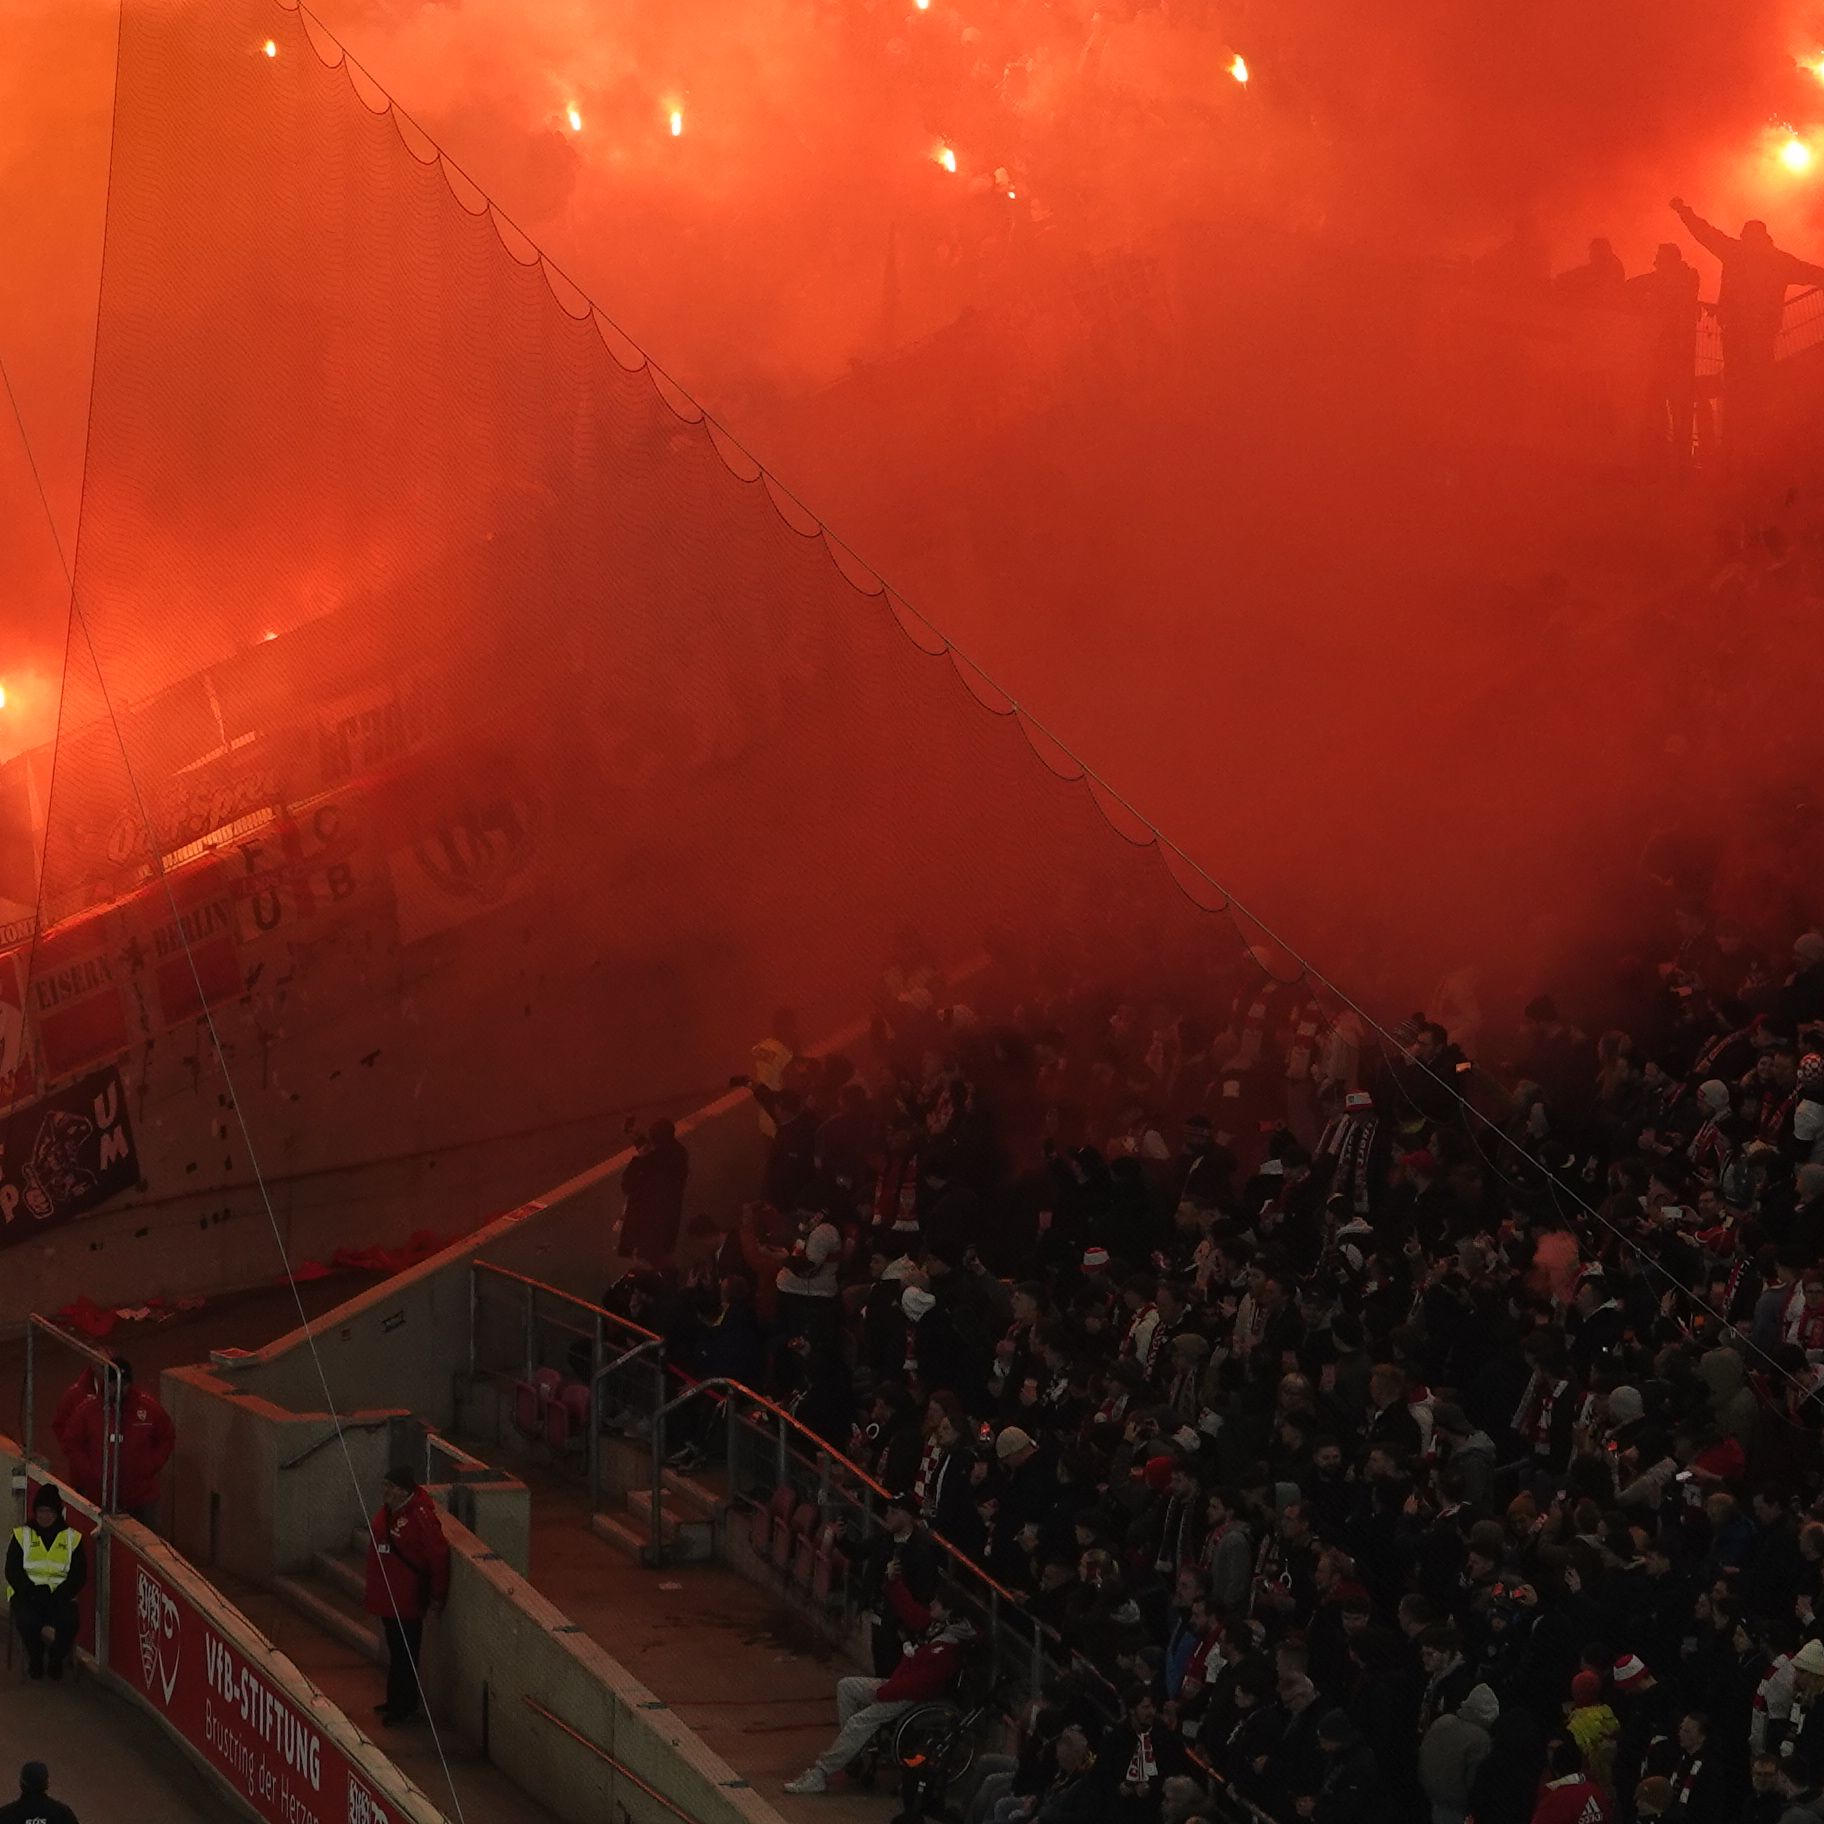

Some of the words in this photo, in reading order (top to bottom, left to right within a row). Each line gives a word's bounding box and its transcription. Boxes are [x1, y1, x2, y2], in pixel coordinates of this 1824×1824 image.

[205, 1632, 321, 1792] VfB-STIFTUNG
[205, 1700, 256, 1798] Brustring
[257, 1754, 276, 1803] der
